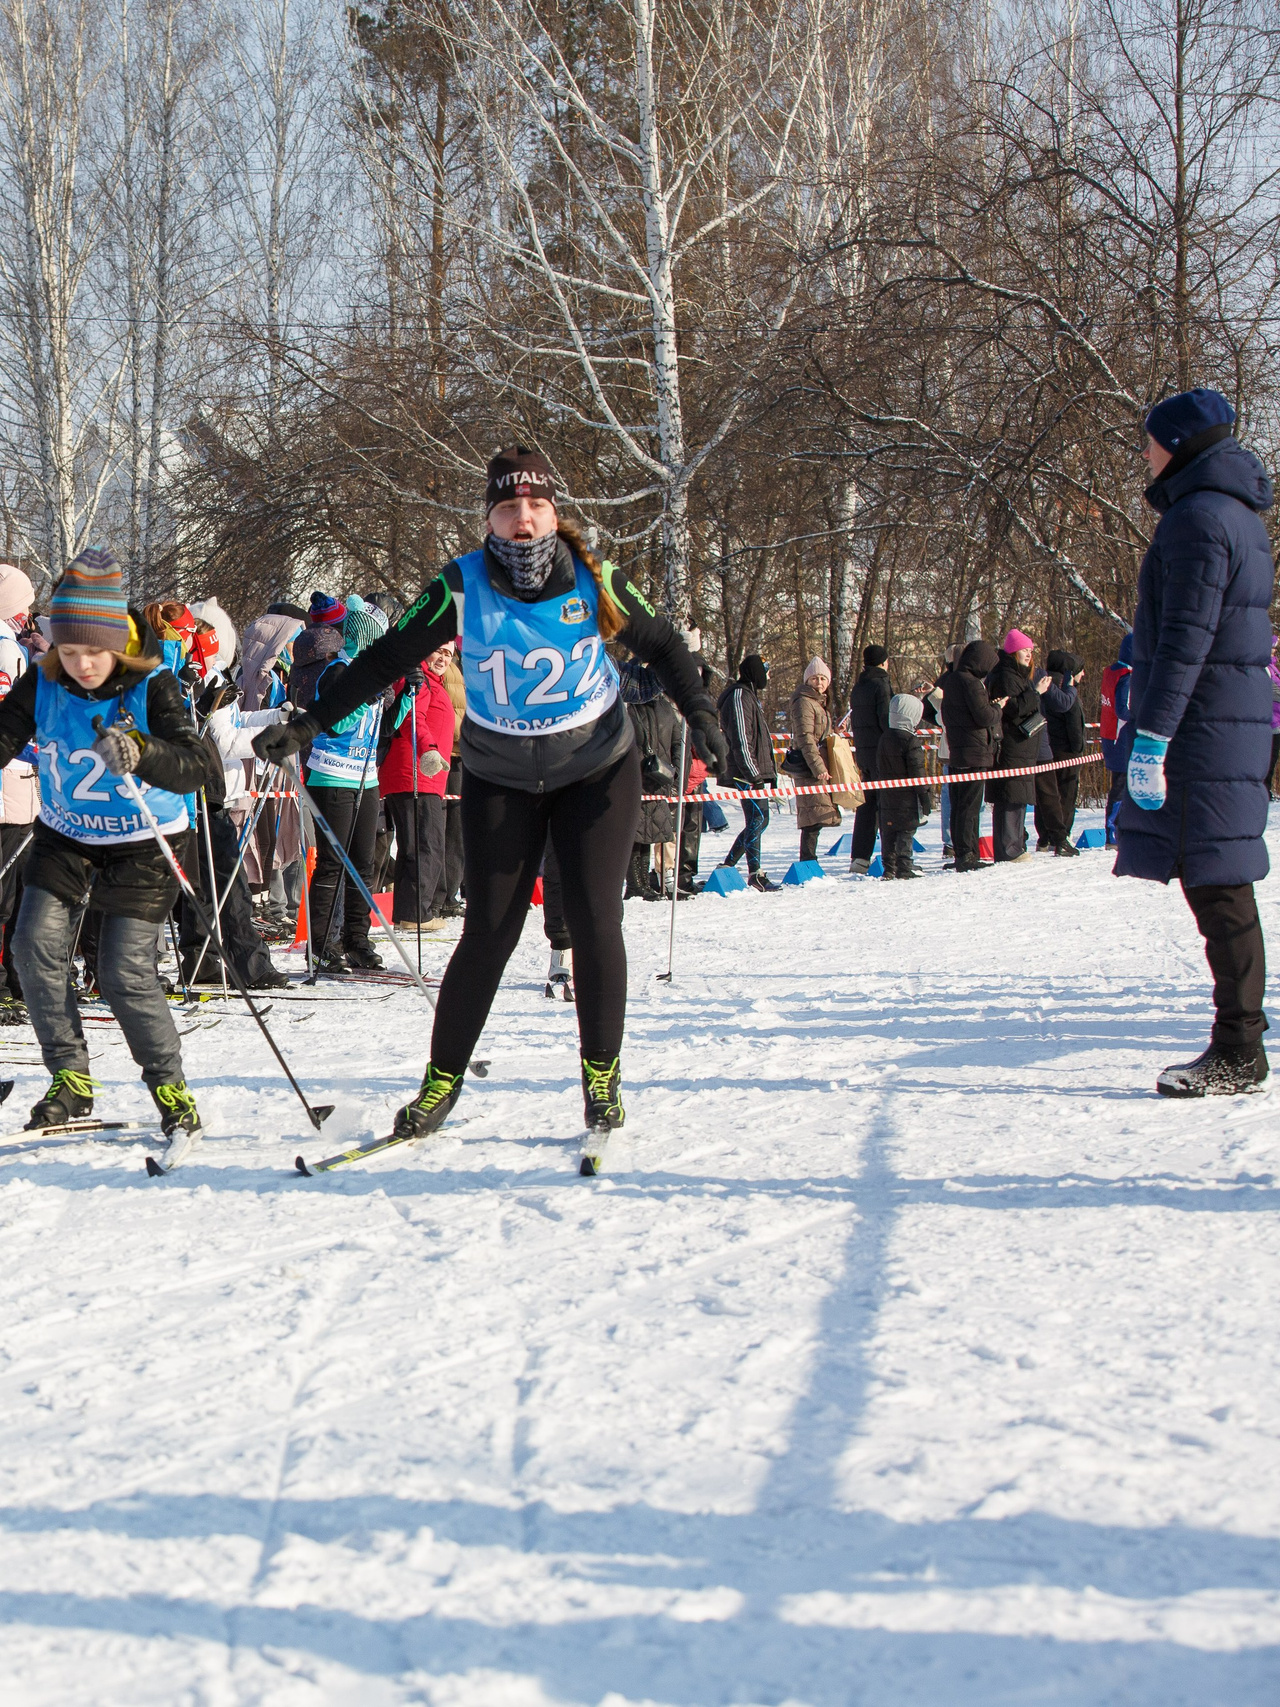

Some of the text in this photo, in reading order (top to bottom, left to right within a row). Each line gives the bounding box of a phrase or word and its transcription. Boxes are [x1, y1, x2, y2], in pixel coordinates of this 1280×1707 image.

[625, 581, 656, 618] BRIKO
[478, 636, 602, 706] 122
[323, 757, 345, 769] КУБОК
